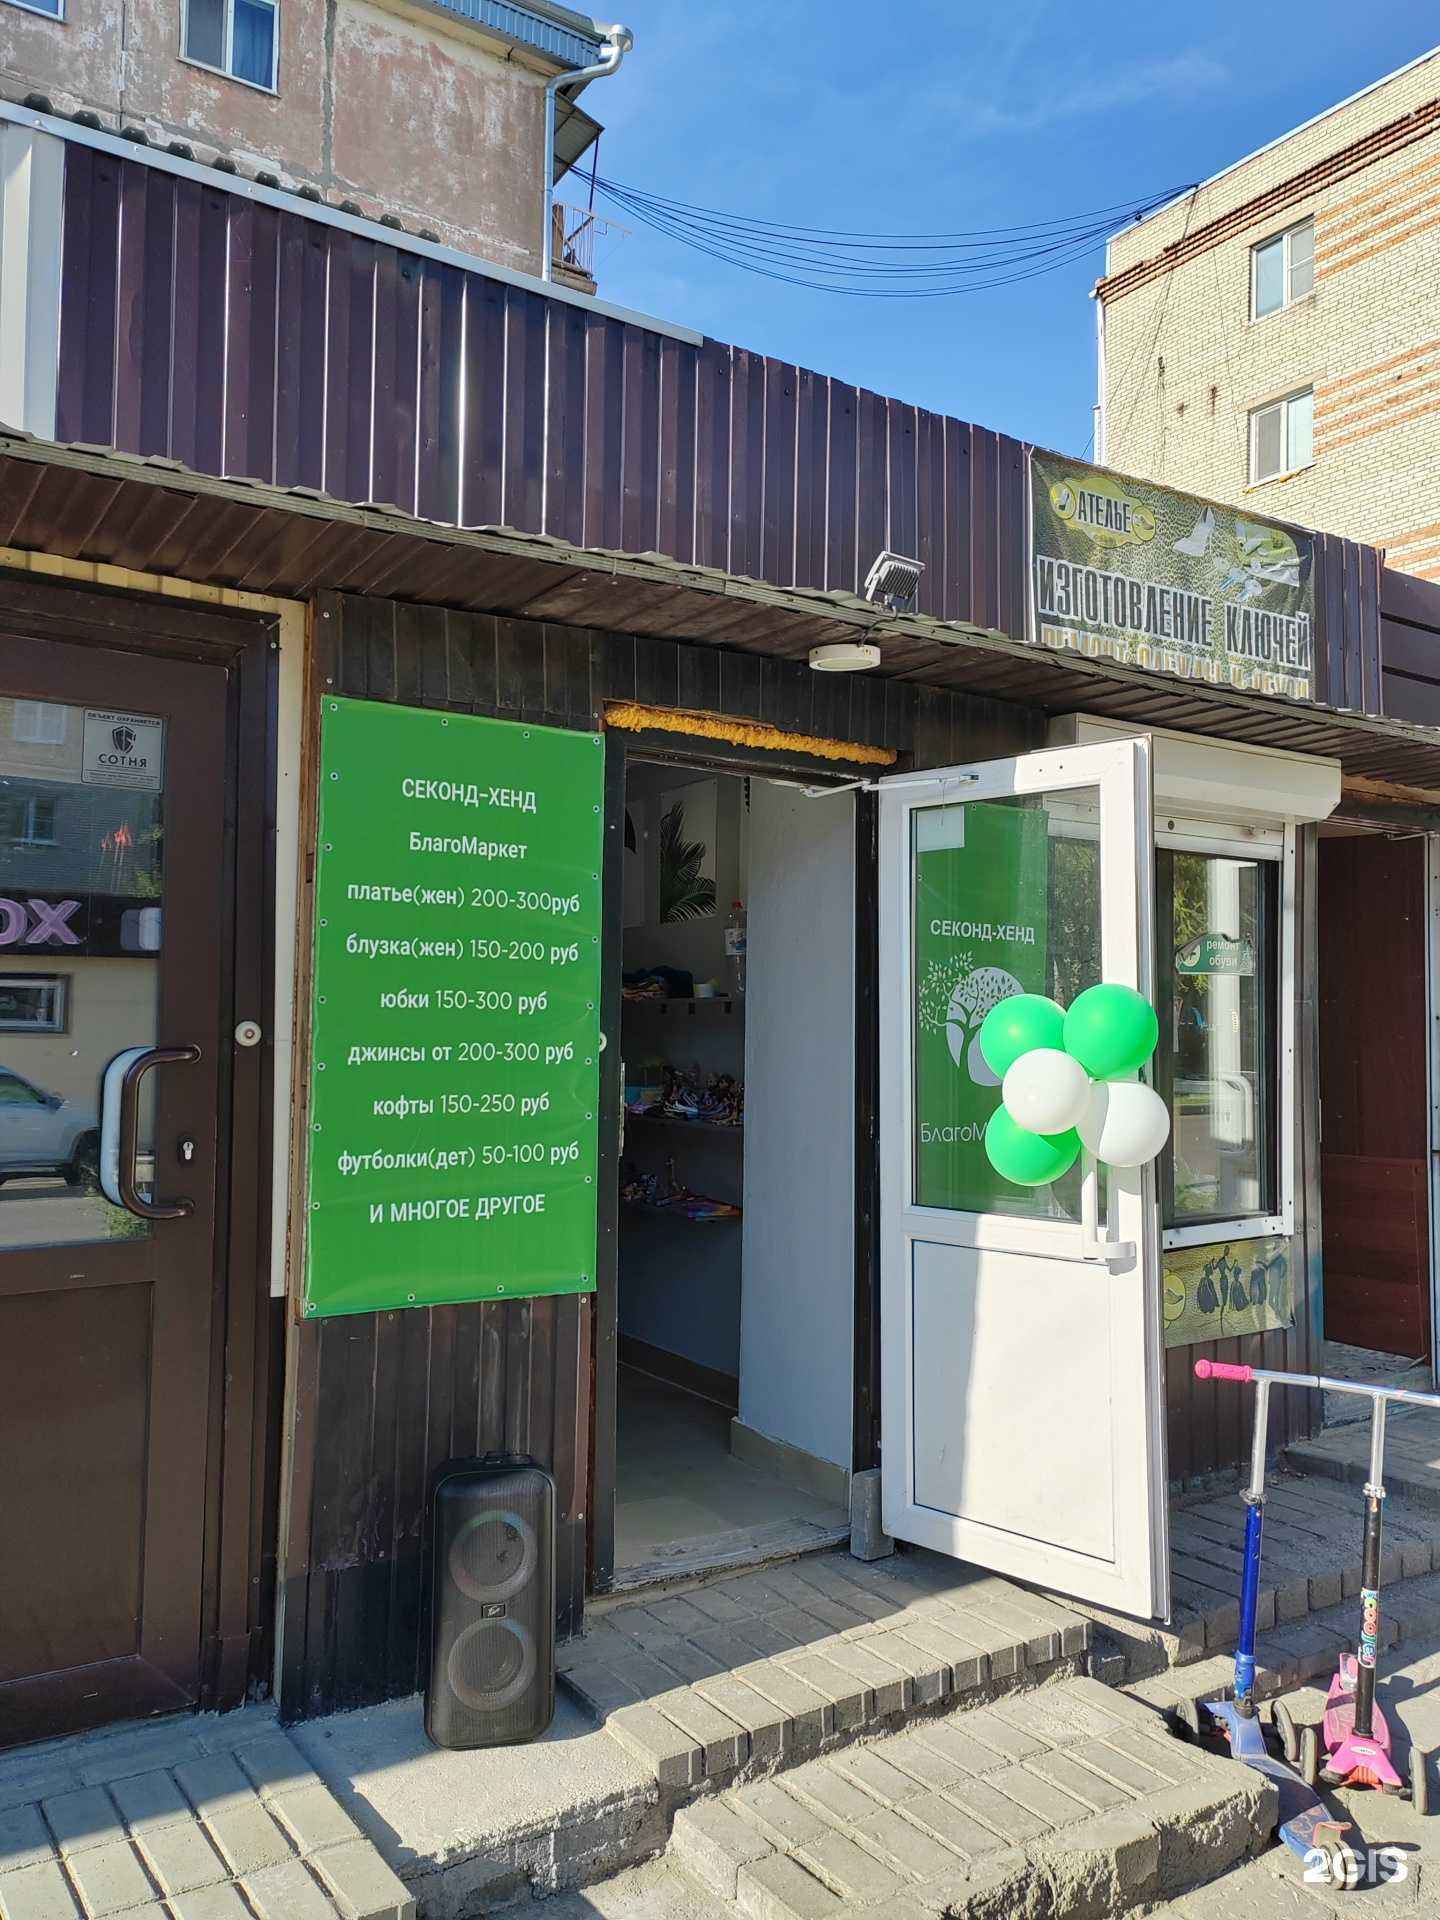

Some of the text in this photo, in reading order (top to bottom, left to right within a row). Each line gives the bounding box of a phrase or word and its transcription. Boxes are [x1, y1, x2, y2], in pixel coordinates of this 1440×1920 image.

[1077, 490, 1131, 533] АТЕЛЬЕ
[1038, 557, 1213, 648] ИЗГОТОВЛЕНИЕ
[1225, 604, 1312, 669] КЛЮЧЕЙ
[98, 753, 148, 768] СОТНЯ
[402, 778, 537, 815] СЕКОНД-ХЕНД
[409, 831, 528, 861] БлагоМаркет
[347, 884, 580, 917] платье(жен) 200-300руб
[930, 919, 1035, 945] СЕКОНД-ХЕНД
[1206, 940, 1239, 952] ремонт
[346, 932, 579, 966] блузка(жен) 150-200 руб
[380, 987, 548, 1015] юбки 150-300 руб
[347, 1041, 574, 1066] джинсы от 200-300 руб
[373, 1091, 550, 1120] кофты 150-250 руб
[920, 1122, 988, 1143] БлагоМ
[337, 1140, 580, 1176] футболки(дет) 50-100 руб
[369, 1193, 546, 1224] И МНОГОЕ ДРУГОЕ
